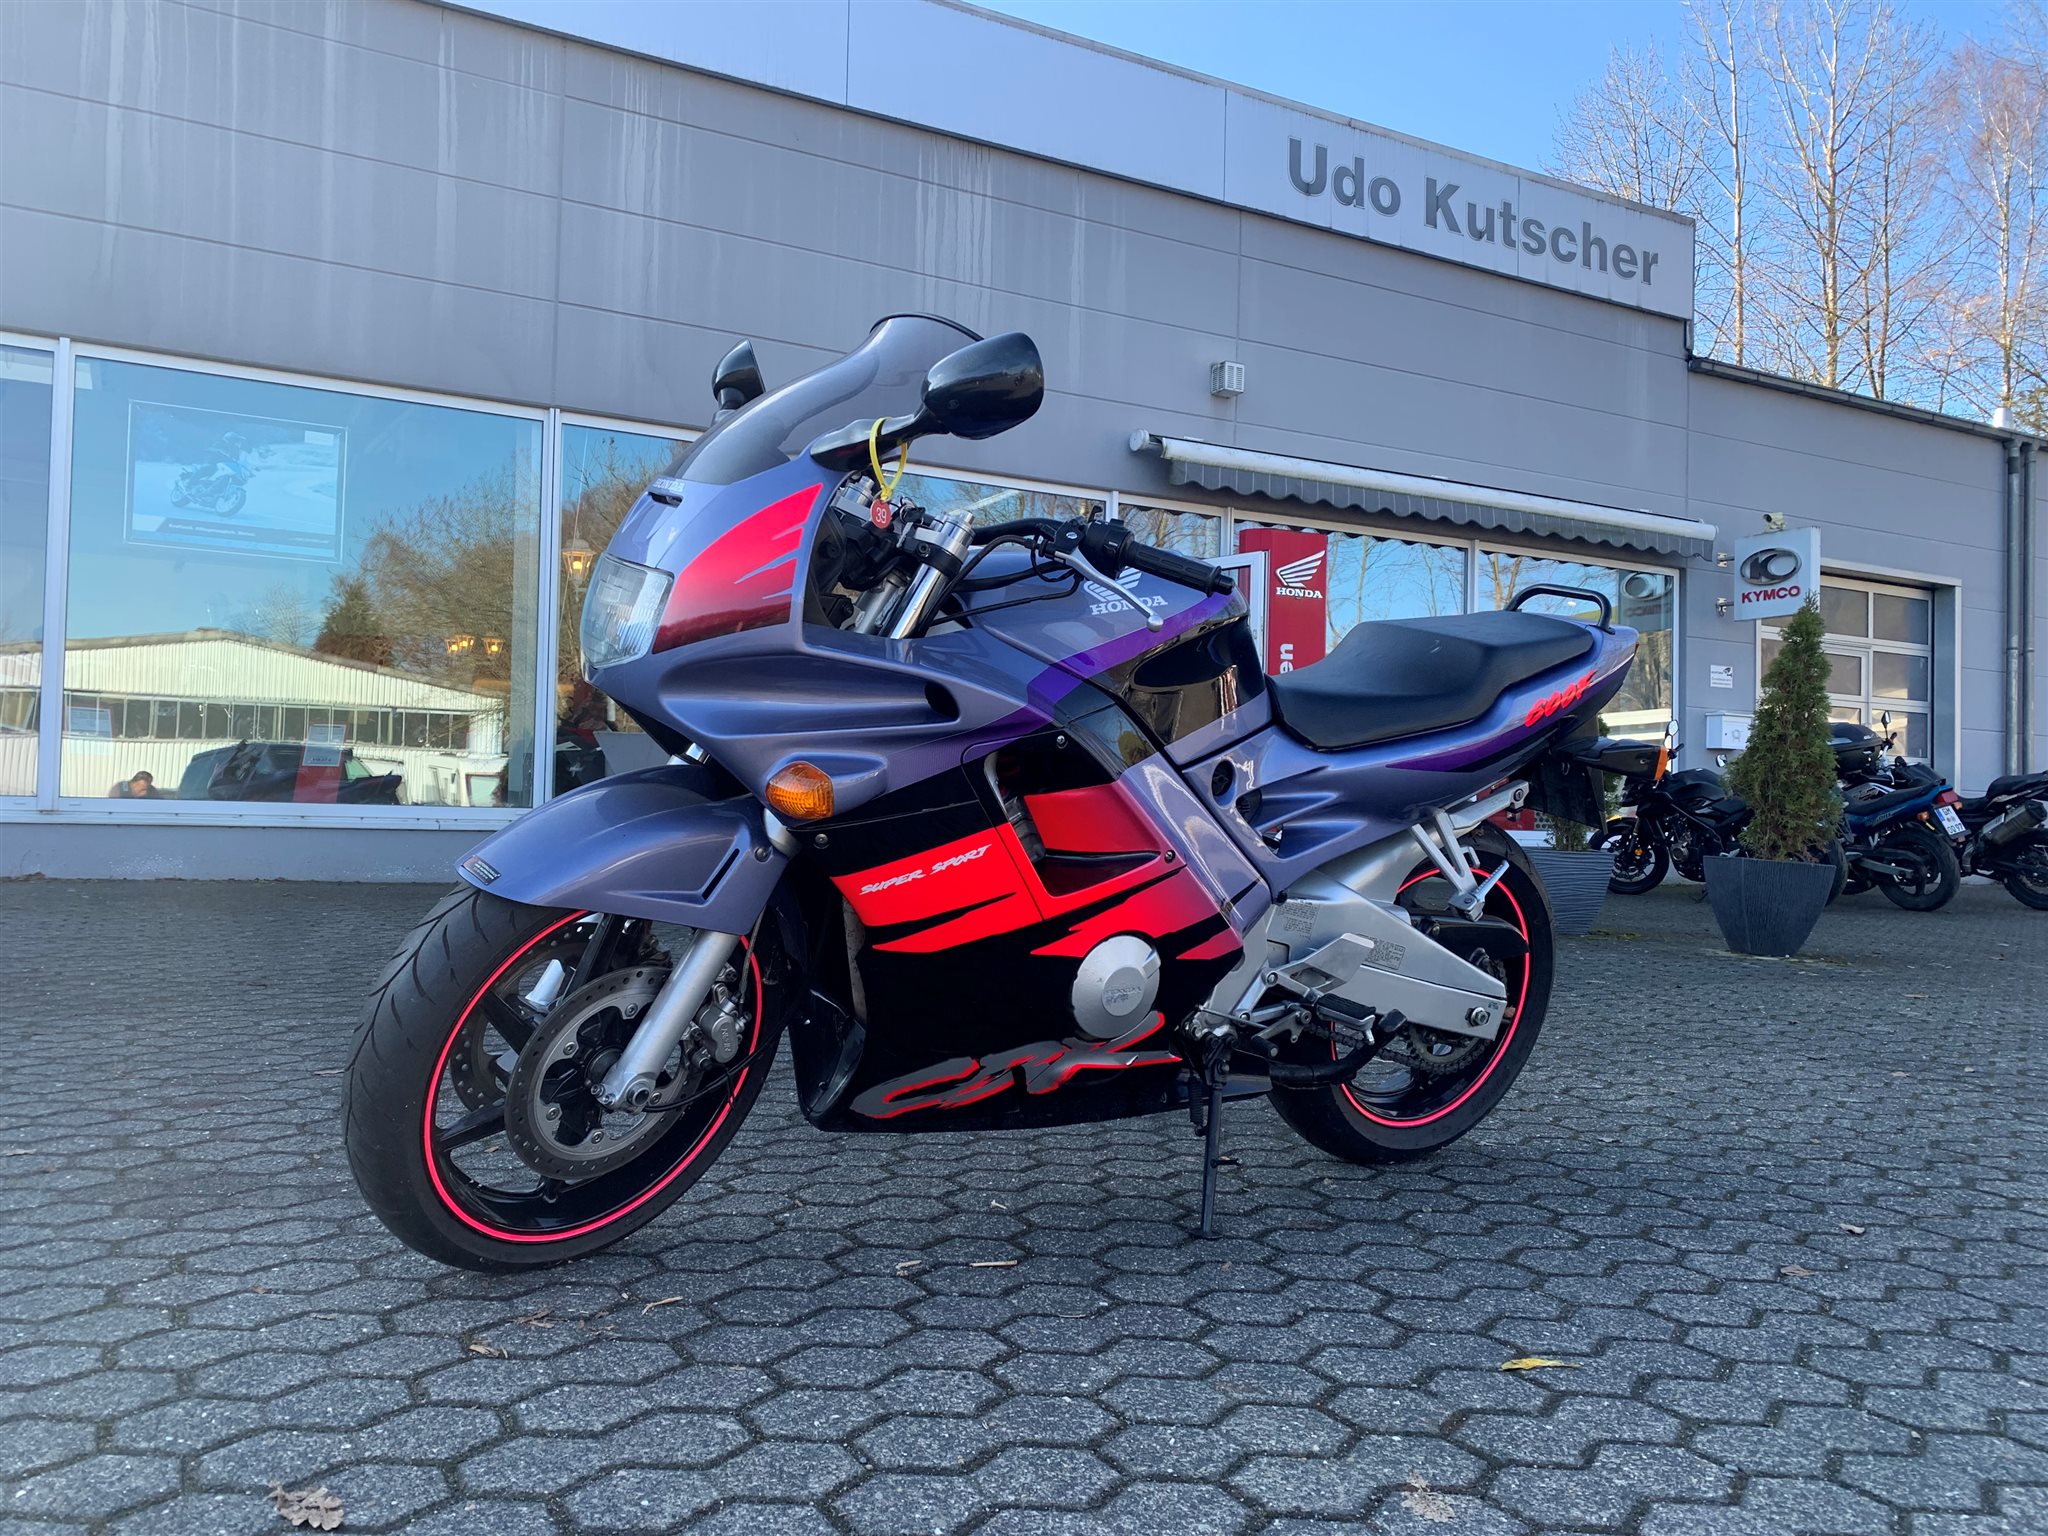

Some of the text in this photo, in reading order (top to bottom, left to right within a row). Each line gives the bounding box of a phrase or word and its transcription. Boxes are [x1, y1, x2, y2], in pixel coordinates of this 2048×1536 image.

[1288, 137, 1659, 285] Udo Kutscher
[876, 507, 887, 524] 39
[1276, 587, 1323, 599] HONDA
[1741, 585, 1801, 604] KYMCO
[859, 843, 992, 895] SUPER SPORT
